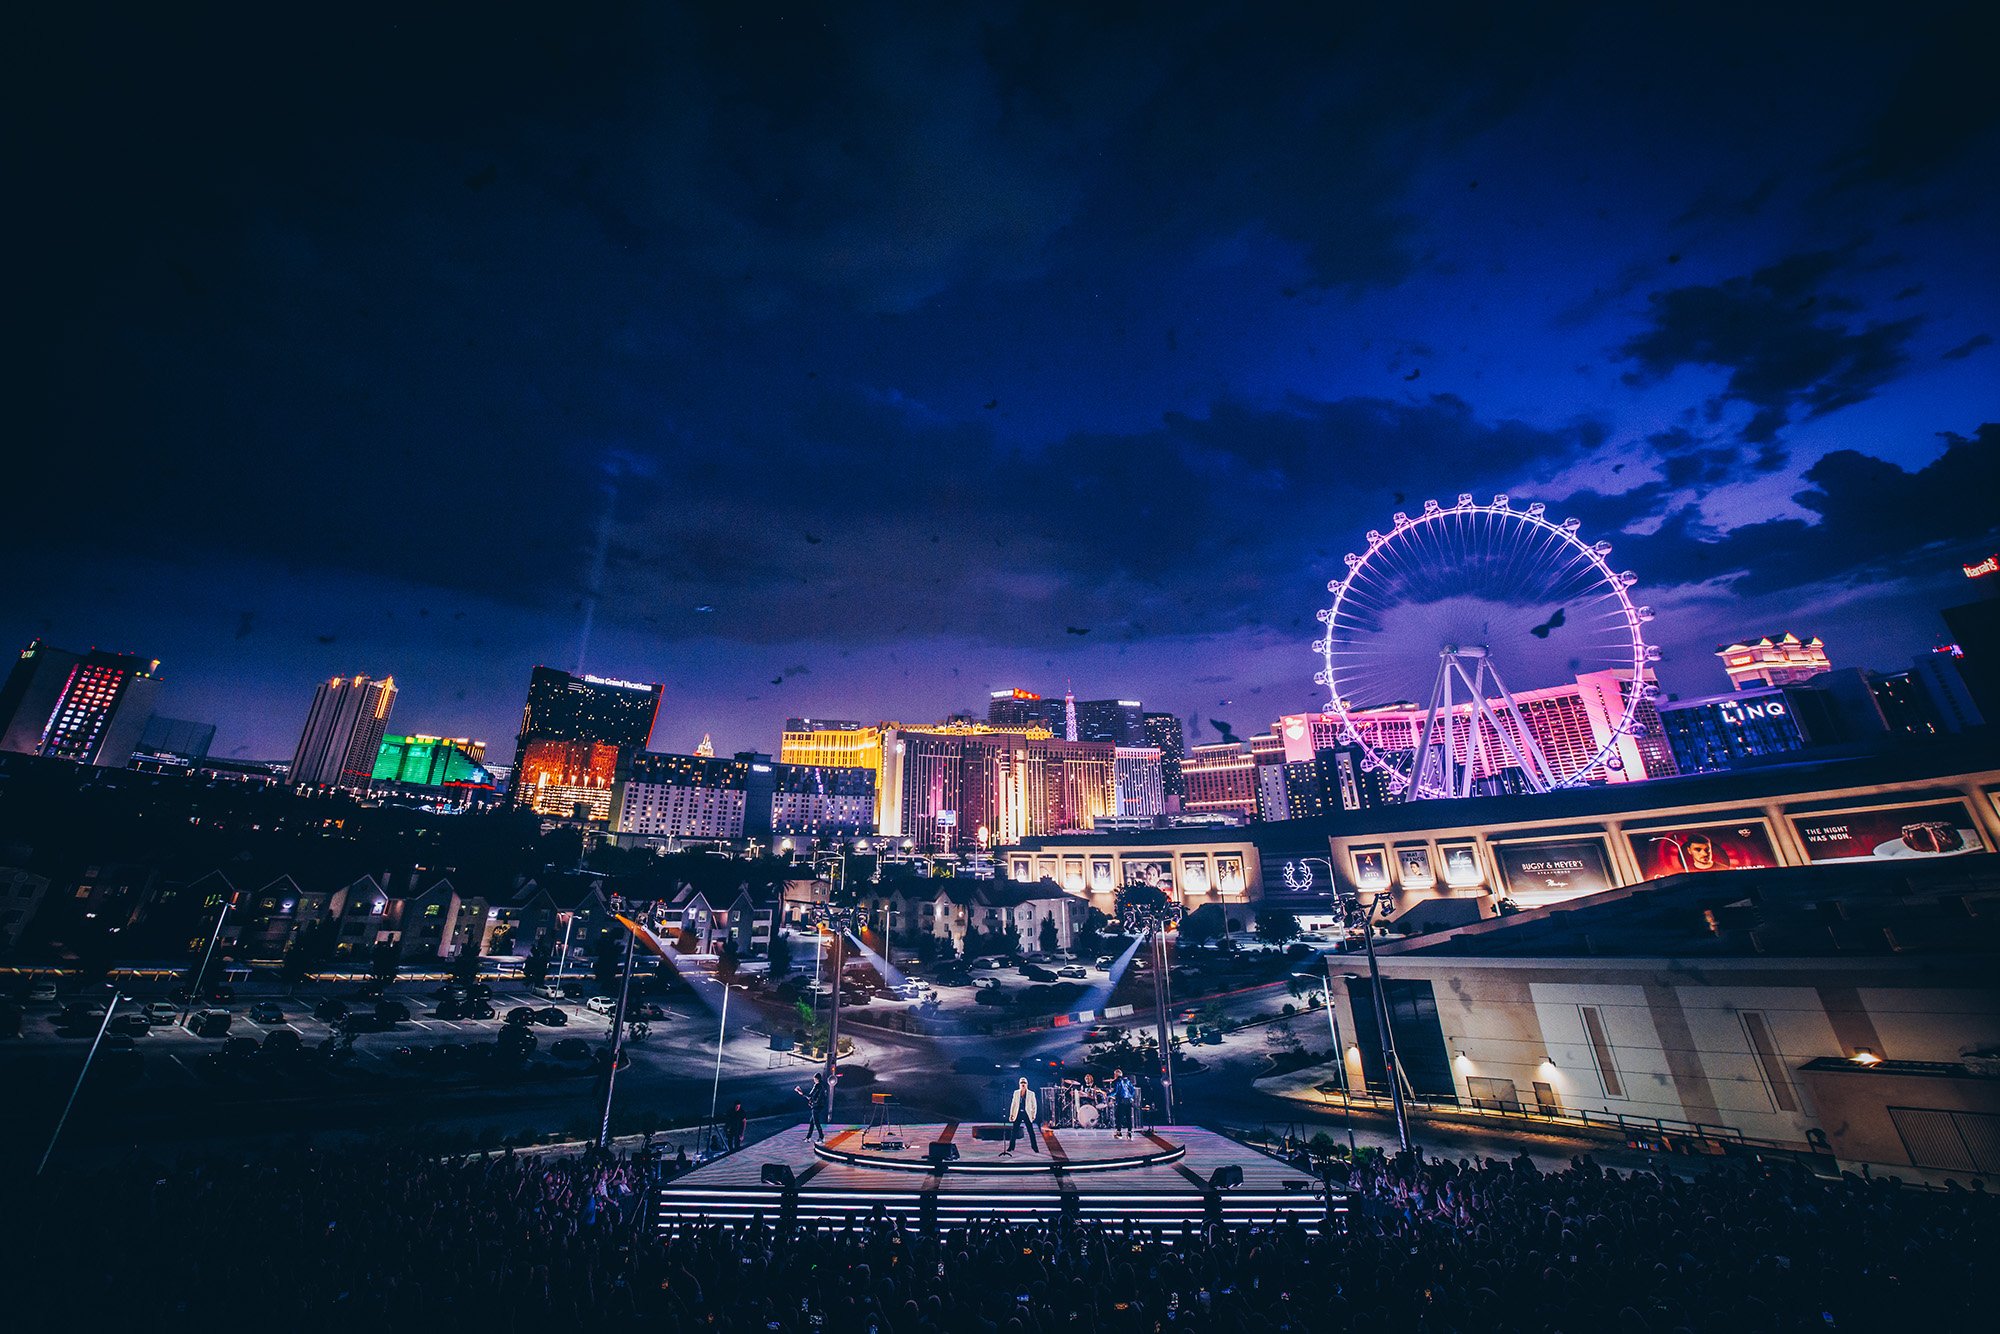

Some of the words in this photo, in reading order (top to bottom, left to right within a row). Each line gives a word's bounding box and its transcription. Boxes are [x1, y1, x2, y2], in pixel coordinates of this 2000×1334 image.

[1963, 557, 1998, 578] Harrah's
[585, 674, 604, 684] Hilton
[605, 678, 624, 687] Grand
[624, 680, 652, 691] Vacations
[1719, 701, 1739, 709] THE
[1722, 702, 1786, 723] LINQ
[1823, 825, 1849, 834] NIGHT
[1829, 833, 1853, 841] WON.
[1522, 862, 1545, 871] BUGSY
[1546, 861, 1553, 869] &
[1554, 860, 1584, 869] MEYER'S
